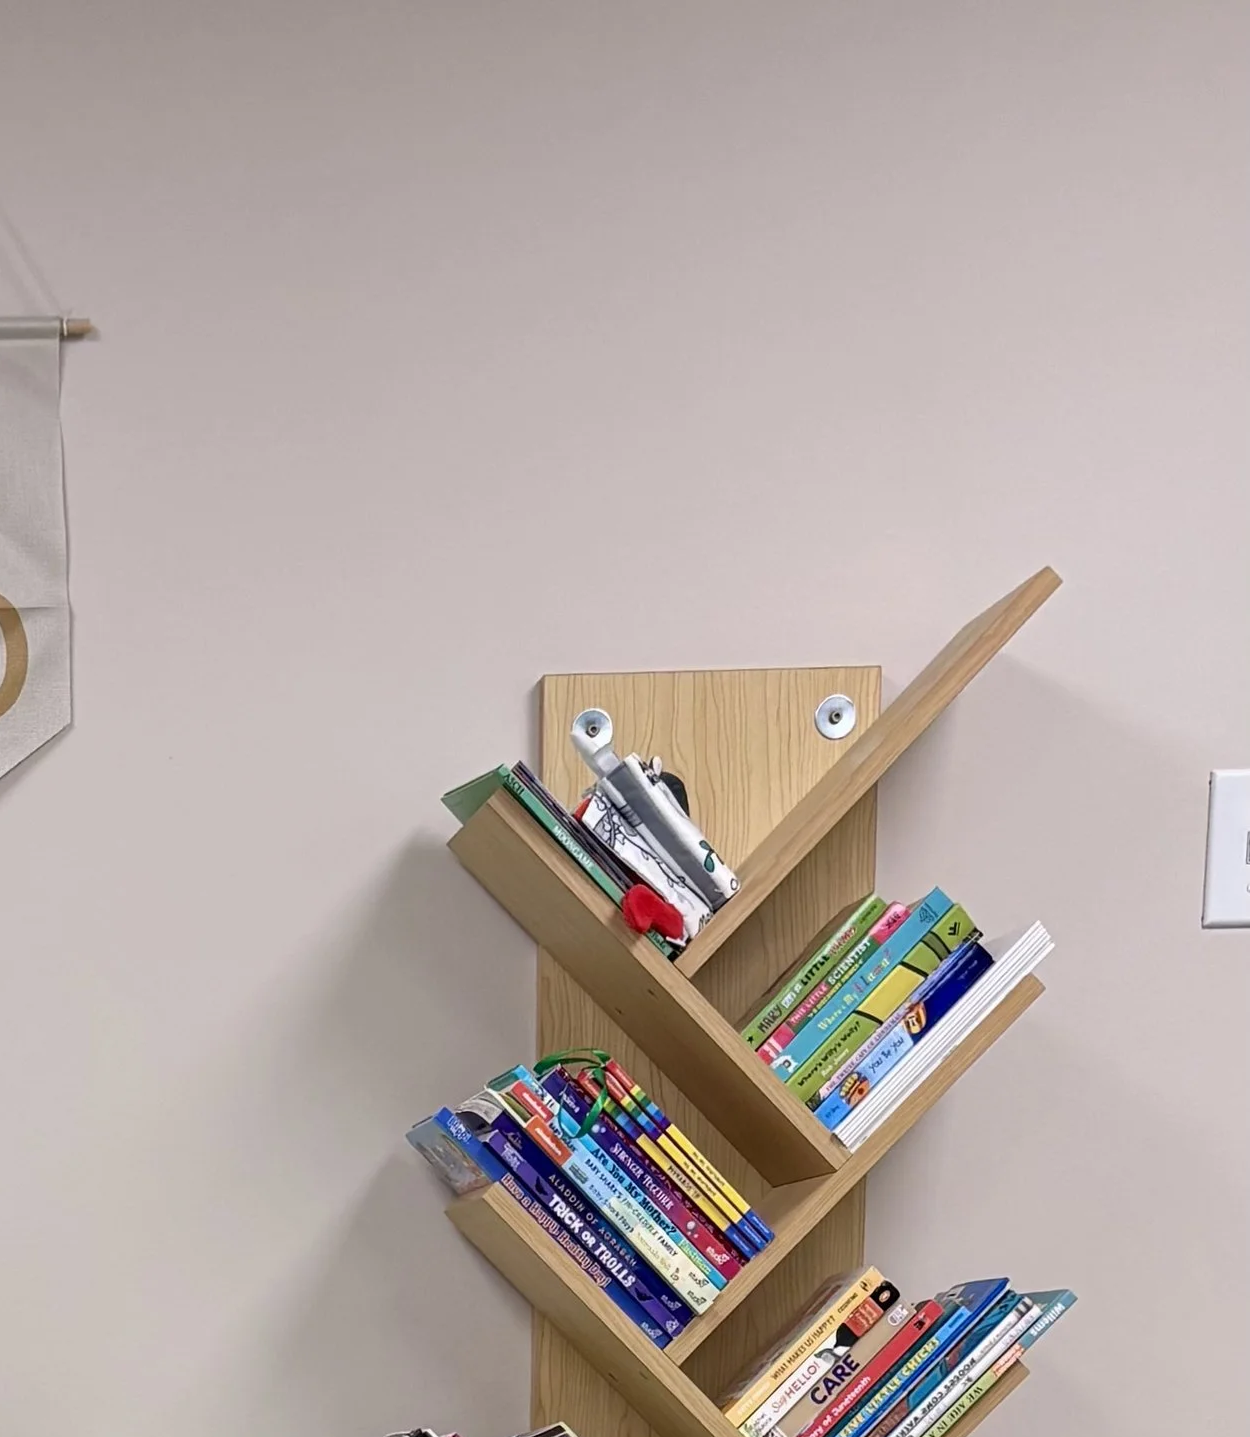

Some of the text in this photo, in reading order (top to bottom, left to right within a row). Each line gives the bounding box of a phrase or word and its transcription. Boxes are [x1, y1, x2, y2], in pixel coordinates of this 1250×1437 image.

[826, 939, 871, 986] SCIENTIST
[755, 952, 832, 1033] MARY LITTLE
[546, 1173, 586, 1214] ALADDIN
[582, 1211, 599, 1228] OF
[589, 1146, 610, 1168] Are
[606, 1164, 627, 1185] You
[623, 1181, 642, 1200] My
[637, 1196, 677, 1237] Mother?
[543, 1193, 586, 1236] TRICK
[590, 1242, 638, 1292] TROLLS
[655, 1234, 679, 1258] FAMILY
[1028, 1300, 1066, 1338] Willems
[782, 1359, 822, 1400] HELLO!
[807, 1351, 862, 1407] CARE
[963, 1383, 983, 1403] WE
[934, 1419, 948, 1433] IN
